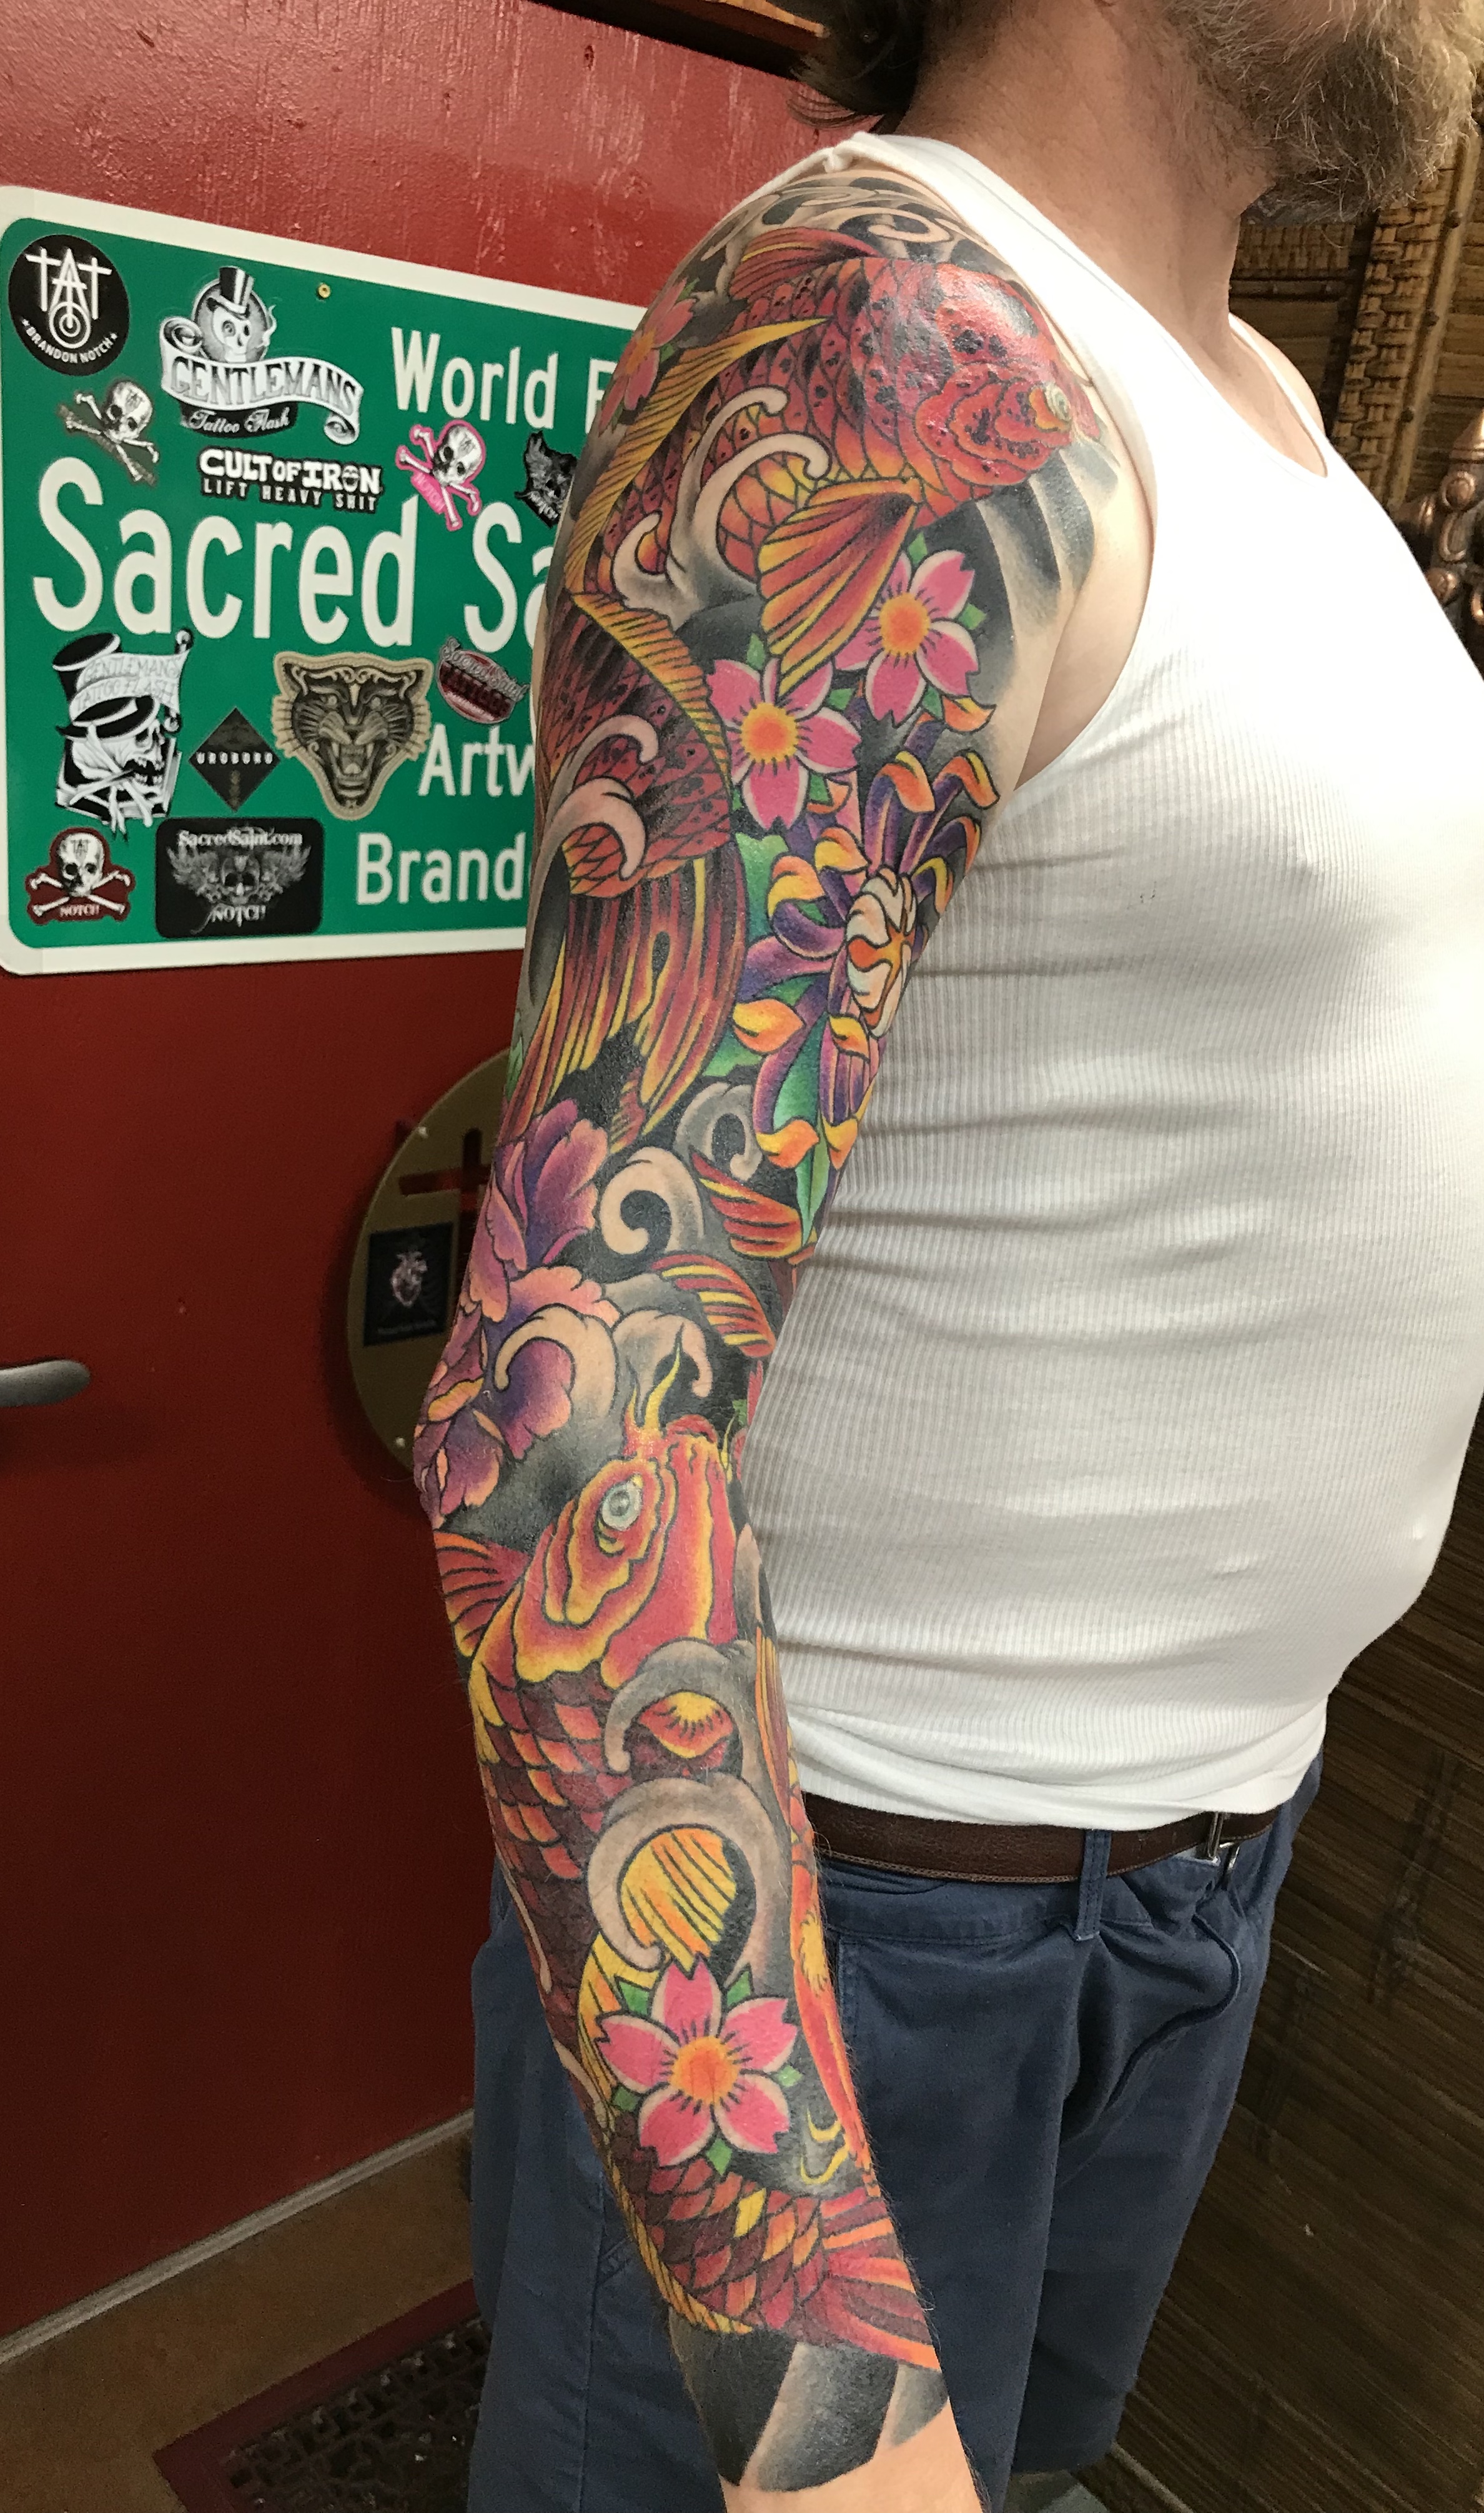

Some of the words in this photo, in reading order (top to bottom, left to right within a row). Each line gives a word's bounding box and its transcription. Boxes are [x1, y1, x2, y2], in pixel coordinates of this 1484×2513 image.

[26, 326, 78, 364] BRANDON
[79, 337, 114, 364] NOTCH
[170, 355, 357, 417] GENTLEMANS
[391, 327, 559, 429] World
[189, 409, 240, 433] Tattoo
[244, 406, 290, 433] Flash
[199, 448, 273, 482] CULT
[272, 460, 302, 482] OF
[301, 460, 381, 495] IRON
[203, 477, 248, 498] LIFT
[260, 484, 322, 506] HEAVY
[334, 491, 377, 512] SHIT
[32, 457, 419, 647] Sacred
[355, 831, 530, 905] Brand
